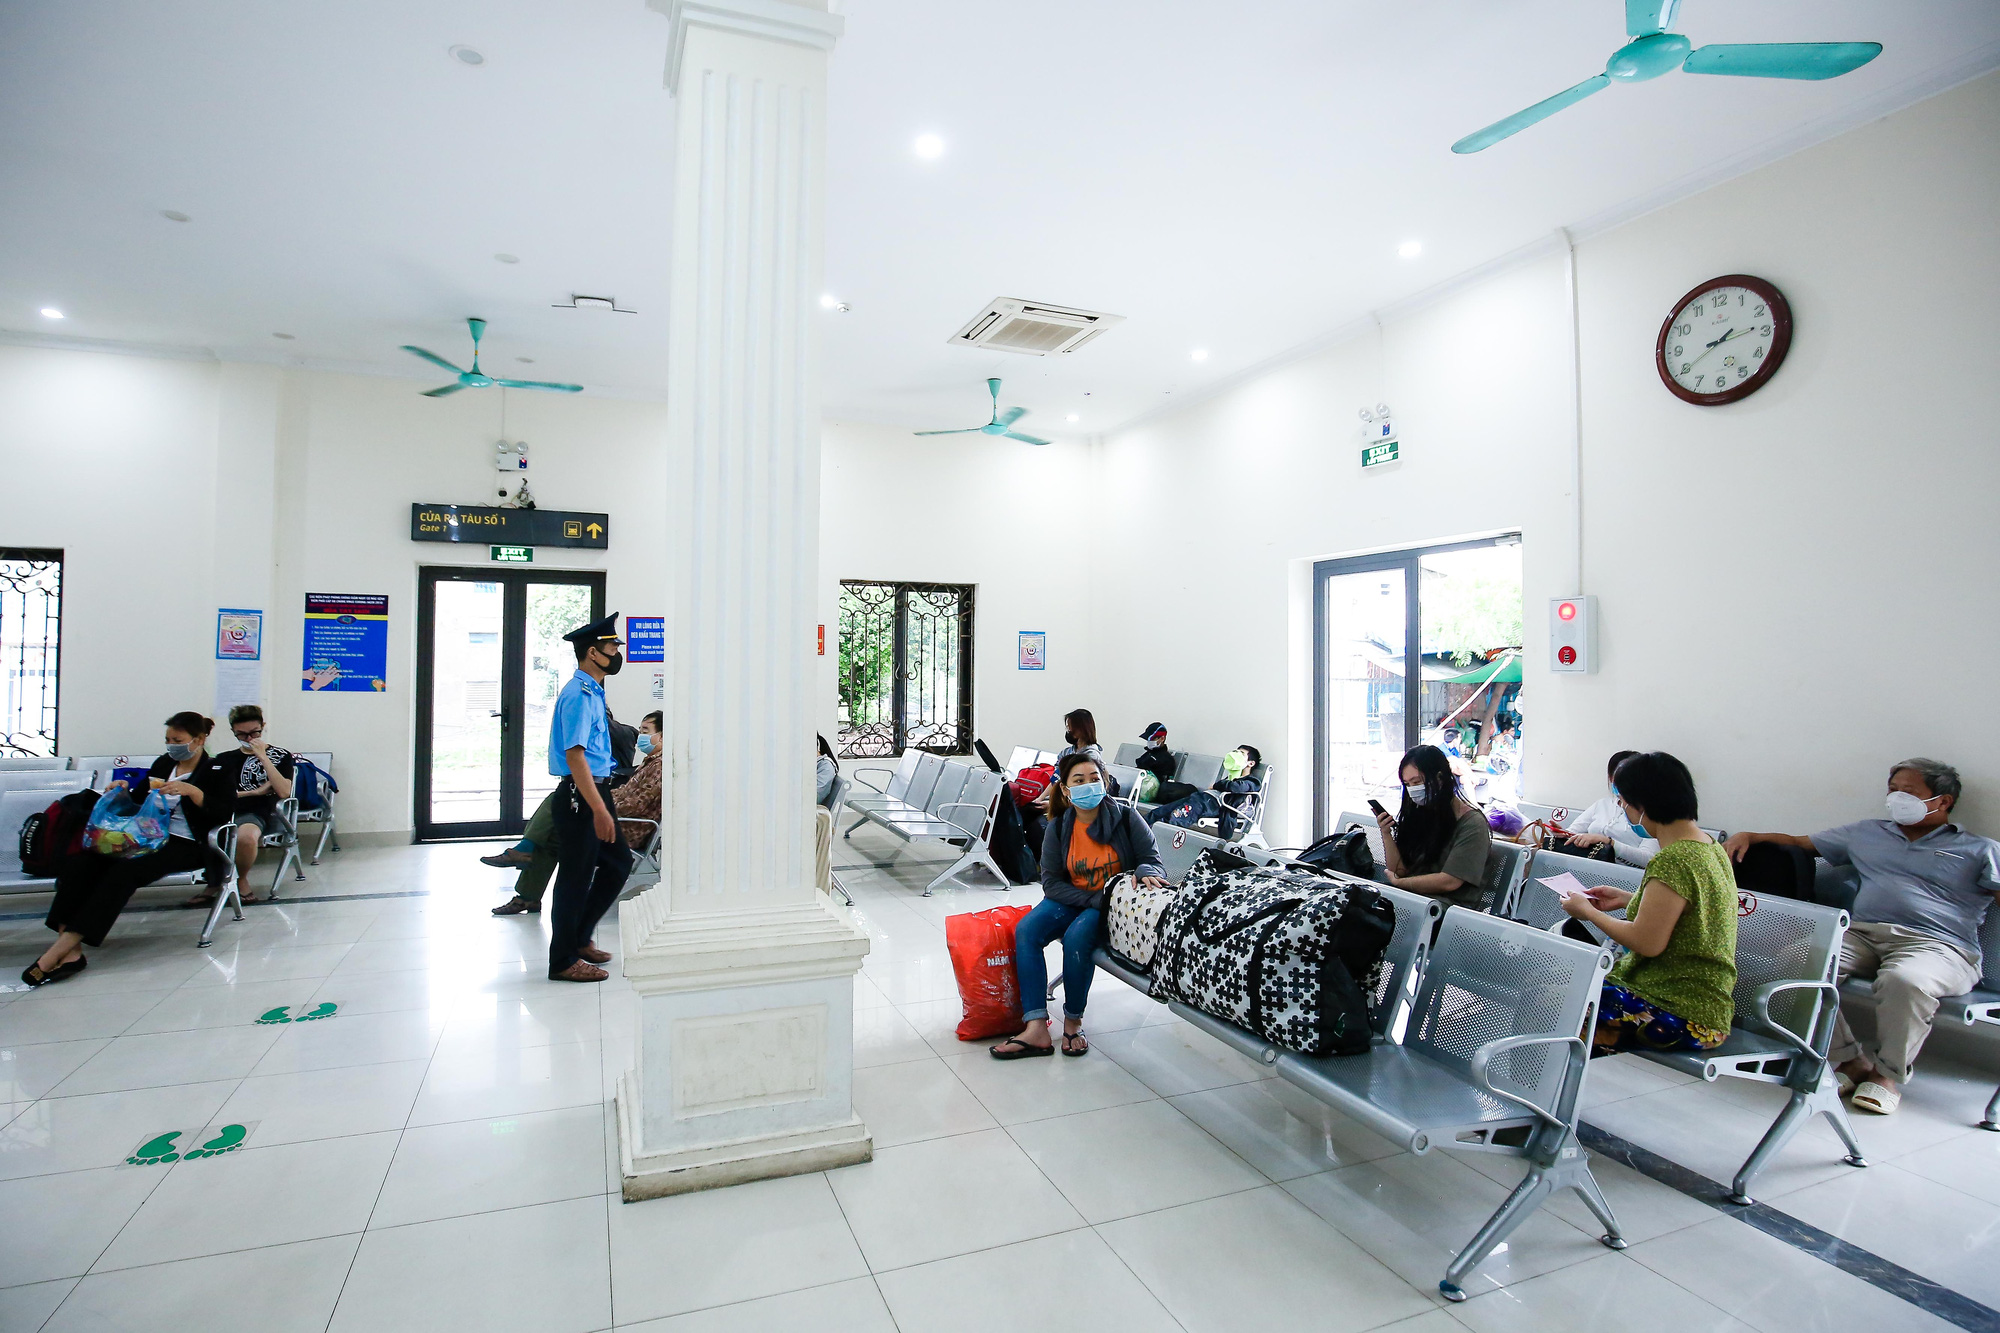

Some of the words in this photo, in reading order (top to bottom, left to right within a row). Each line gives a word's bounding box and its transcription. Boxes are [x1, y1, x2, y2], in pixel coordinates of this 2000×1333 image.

[1712, 294, 1727, 308] 12
[1738, 295, 1744, 306] 1
[1693, 305, 1703, 317] 11
[1754, 305, 1764, 318] 2
[1677, 324, 1691, 337] 10
[1760, 325, 1770, 337] 3
[1674, 346, 1683, 356] 9
[1753, 346, 1763, 358] 4
[1682, 363, 1690, 374] 8
[1738, 366, 1748, 378] 5
[1695, 375, 1704, 387] 7
[1716, 376, 1725, 387] 6
[1369, 445, 1391, 457] EXIT
[420, 510, 441, 522] CỬA
[444, 514, 458, 523] RA
[461, 513, 481, 524] TÀU
[484, 513, 498, 525] SỐ
[501, 517, 506, 525] 1
